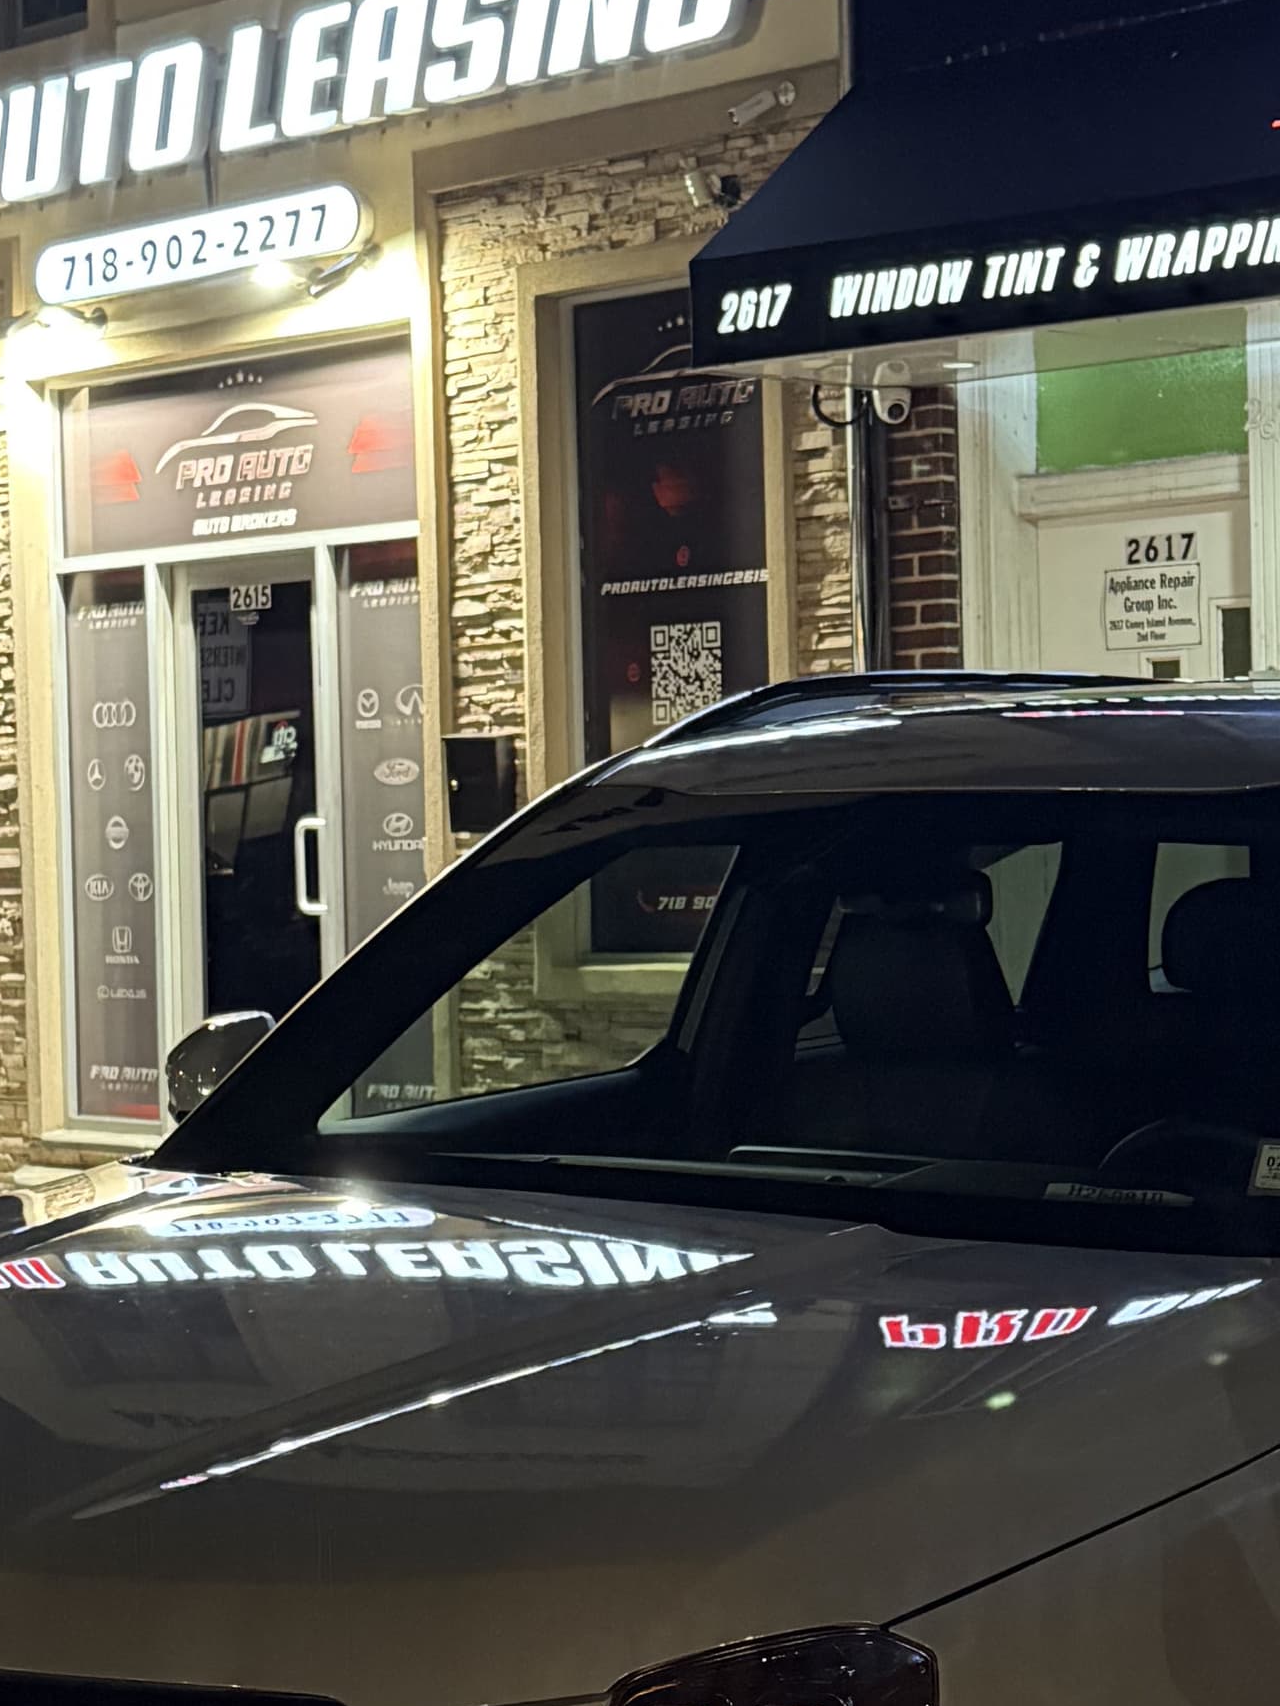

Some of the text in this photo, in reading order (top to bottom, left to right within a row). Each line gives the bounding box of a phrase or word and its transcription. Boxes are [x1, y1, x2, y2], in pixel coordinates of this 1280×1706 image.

[63, 204, 326, 291] 718-902-2277
[718, 283, 792, 334] 2617
[829, 260, 972, 319] WINDOW
[982, 243, 1066, 300] TINT
[1074, 242, 1101, 288] &
[611, 377, 755, 421] PRO AUTO
[176, 444, 313, 491] PRO AUTO
[196, 482, 292, 509] LEASING
[1126, 533, 1195, 565] 2617
[385, 576, 420, 594] AUT
[1108, 571, 1196, 596] Appliance Repair
[232, 585, 270, 610] 2615
[1123, 594, 1177, 614] Group Inc.
[372, 839, 424, 851] HYUNDA
[657, 895, 717, 910] 718 90
